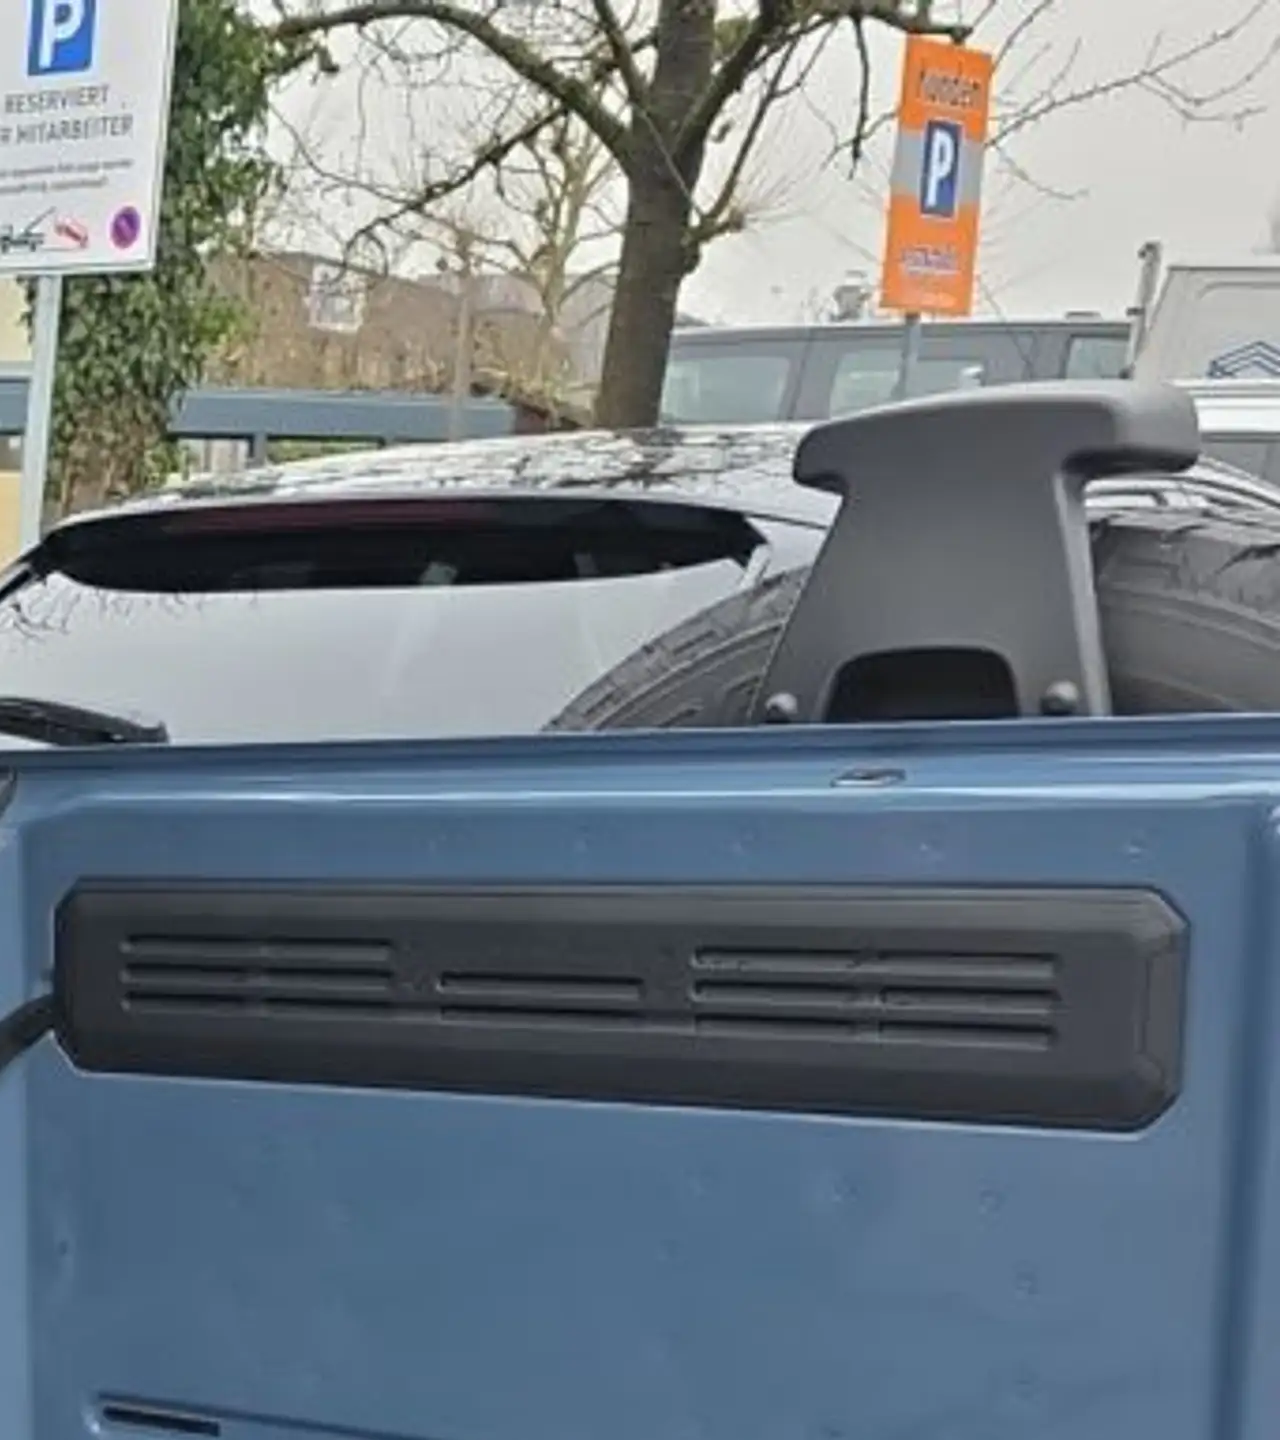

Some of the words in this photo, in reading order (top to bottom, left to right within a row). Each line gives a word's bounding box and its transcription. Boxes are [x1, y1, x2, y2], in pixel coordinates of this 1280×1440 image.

[38, 0, 86, 69] P
[4, 85, 111, 116] RESERVIERT
[15, 114, 134, 147] MITARBEITER
[925, 128, 955, 208] P
